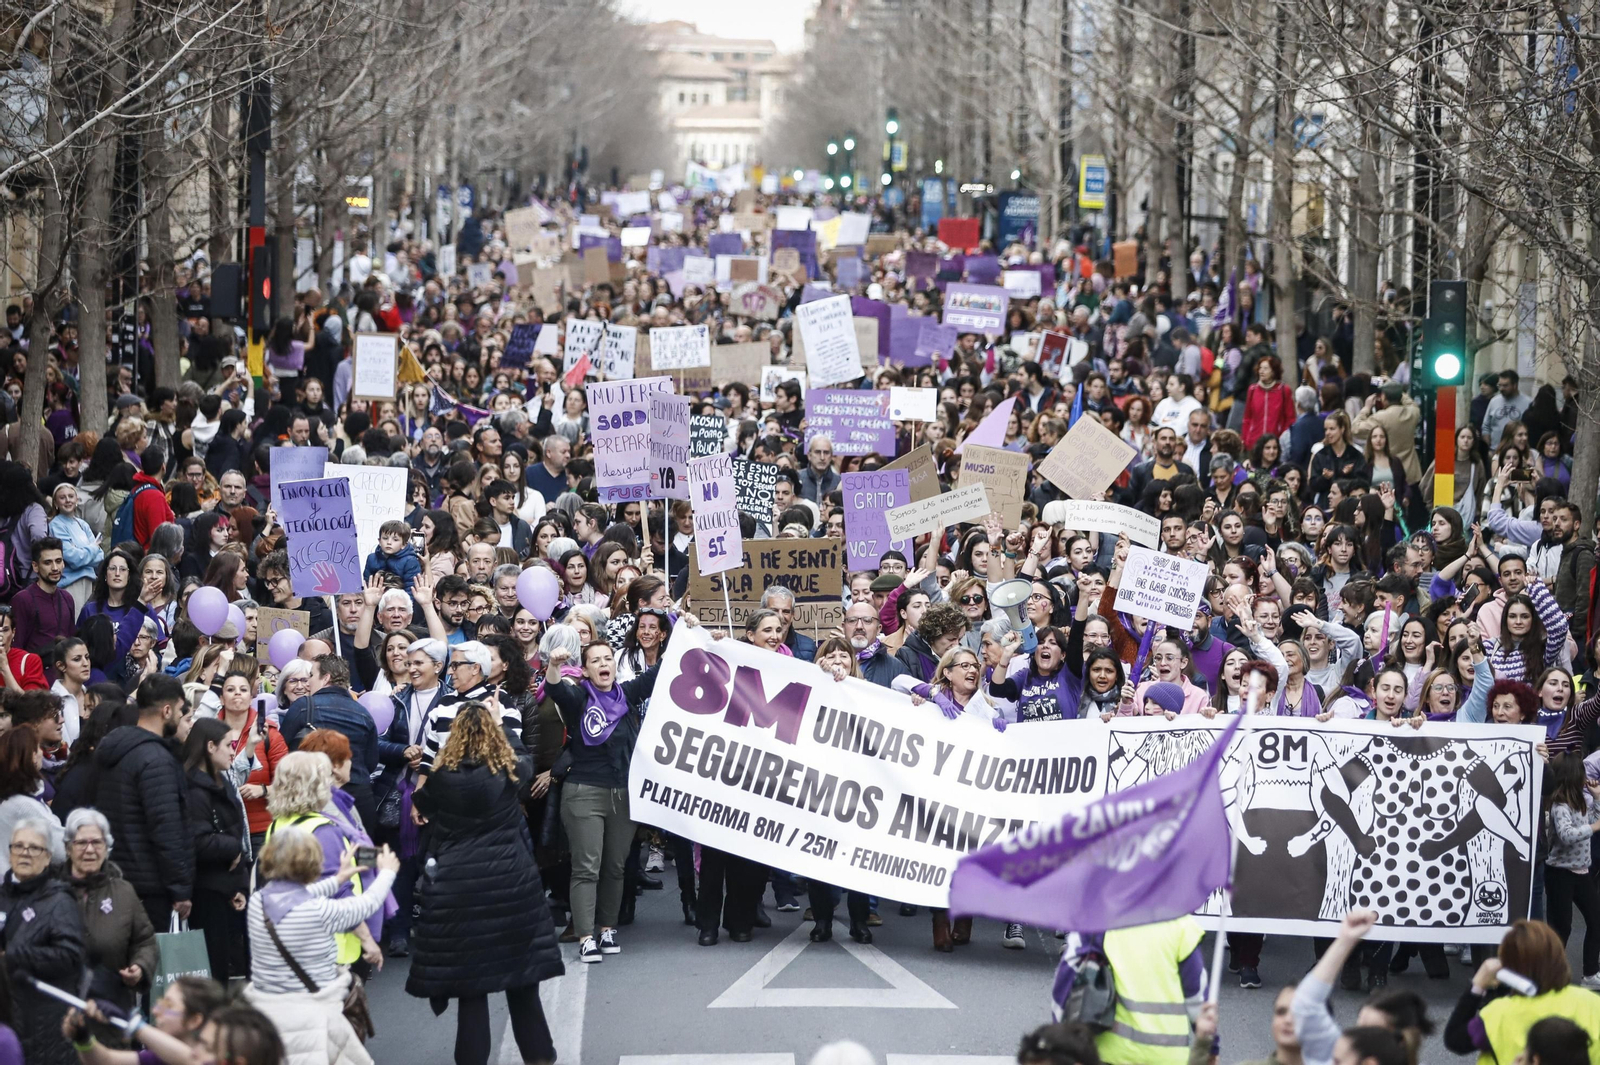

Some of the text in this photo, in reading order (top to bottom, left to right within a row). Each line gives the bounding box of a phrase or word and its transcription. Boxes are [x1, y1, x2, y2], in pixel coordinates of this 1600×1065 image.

[594, 382, 668, 404] MUJERES
[597, 410, 650, 430] SORD
[690, 416, 722, 428] ACOSAN
[662, 425, 674, 438] el
[1076, 420, 1129, 462] NO ES UN
[1068, 434, 1099, 459] CASO
[1054, 451, 1070, 465] SE
[659, 466, 676, 489] YA
[690, 457, 732, 483] PROMESAS
[762, 465, 778, 475] NO
[964, 462, 996, 475] MUSAS
[281, 478, 350, 500] INNOVACIÓN
[354, 472, 400, 492] CRECIDO
[761, 474, 776, 484] NO
[845, 472, 908, 490] SOMOS EL
[366, 493, 379, 504] EN
[746, 488, 771, 500] NO
[854, 492, 895, 510] GRITO
[889, 508, 918, 522] SOMOS
[922, 500, 936, 510] LAS
[970, 486, 980, 494] LAS
[371, 505, 400, 516] TODAS
[847, 511, 884, 523] DE LAS
[919, 516, 930, 525] QUE
[930, 513, 939, 521] NO
[1068, 500, 1080, 512] SI
[1085, 503, 1116, 512] NOSOTRAS
[1118, 506, 1133, 516] SOMOS
[1134, 512, 1143, 520] LAS
[285, 510, 355, 534] TECNOLOGÍA
[708, 530, 727, 558] SÍ
[848, 539, 879, 559] VOZ
[290, 540, 359, 578] ACCESIBLE
[760, 549, 780, 570] ME
[1152, 555, 1171, 568] SOY
[1170, 560, 1181, 572] LA
[710, 574, 820, 594] SOLA PORQUE
[1135, 577, 1196, 603] DE LAS NIÑAS
[1118, 588, 1136, 602] QUE
[792, 605, 842, 624] JUNTAS
[669, 648, 1098, 795] 8M UNIDAS Y LUCHANDO
[1257, 732, 1310, 764] 8M
[654, 720, 884, 830] SEGUIREMOS
[888, 793, 1038, 855] AVANZ
[640, 779, 947, 887] PLATAFORMA 8M / 25N FEMINISMO
